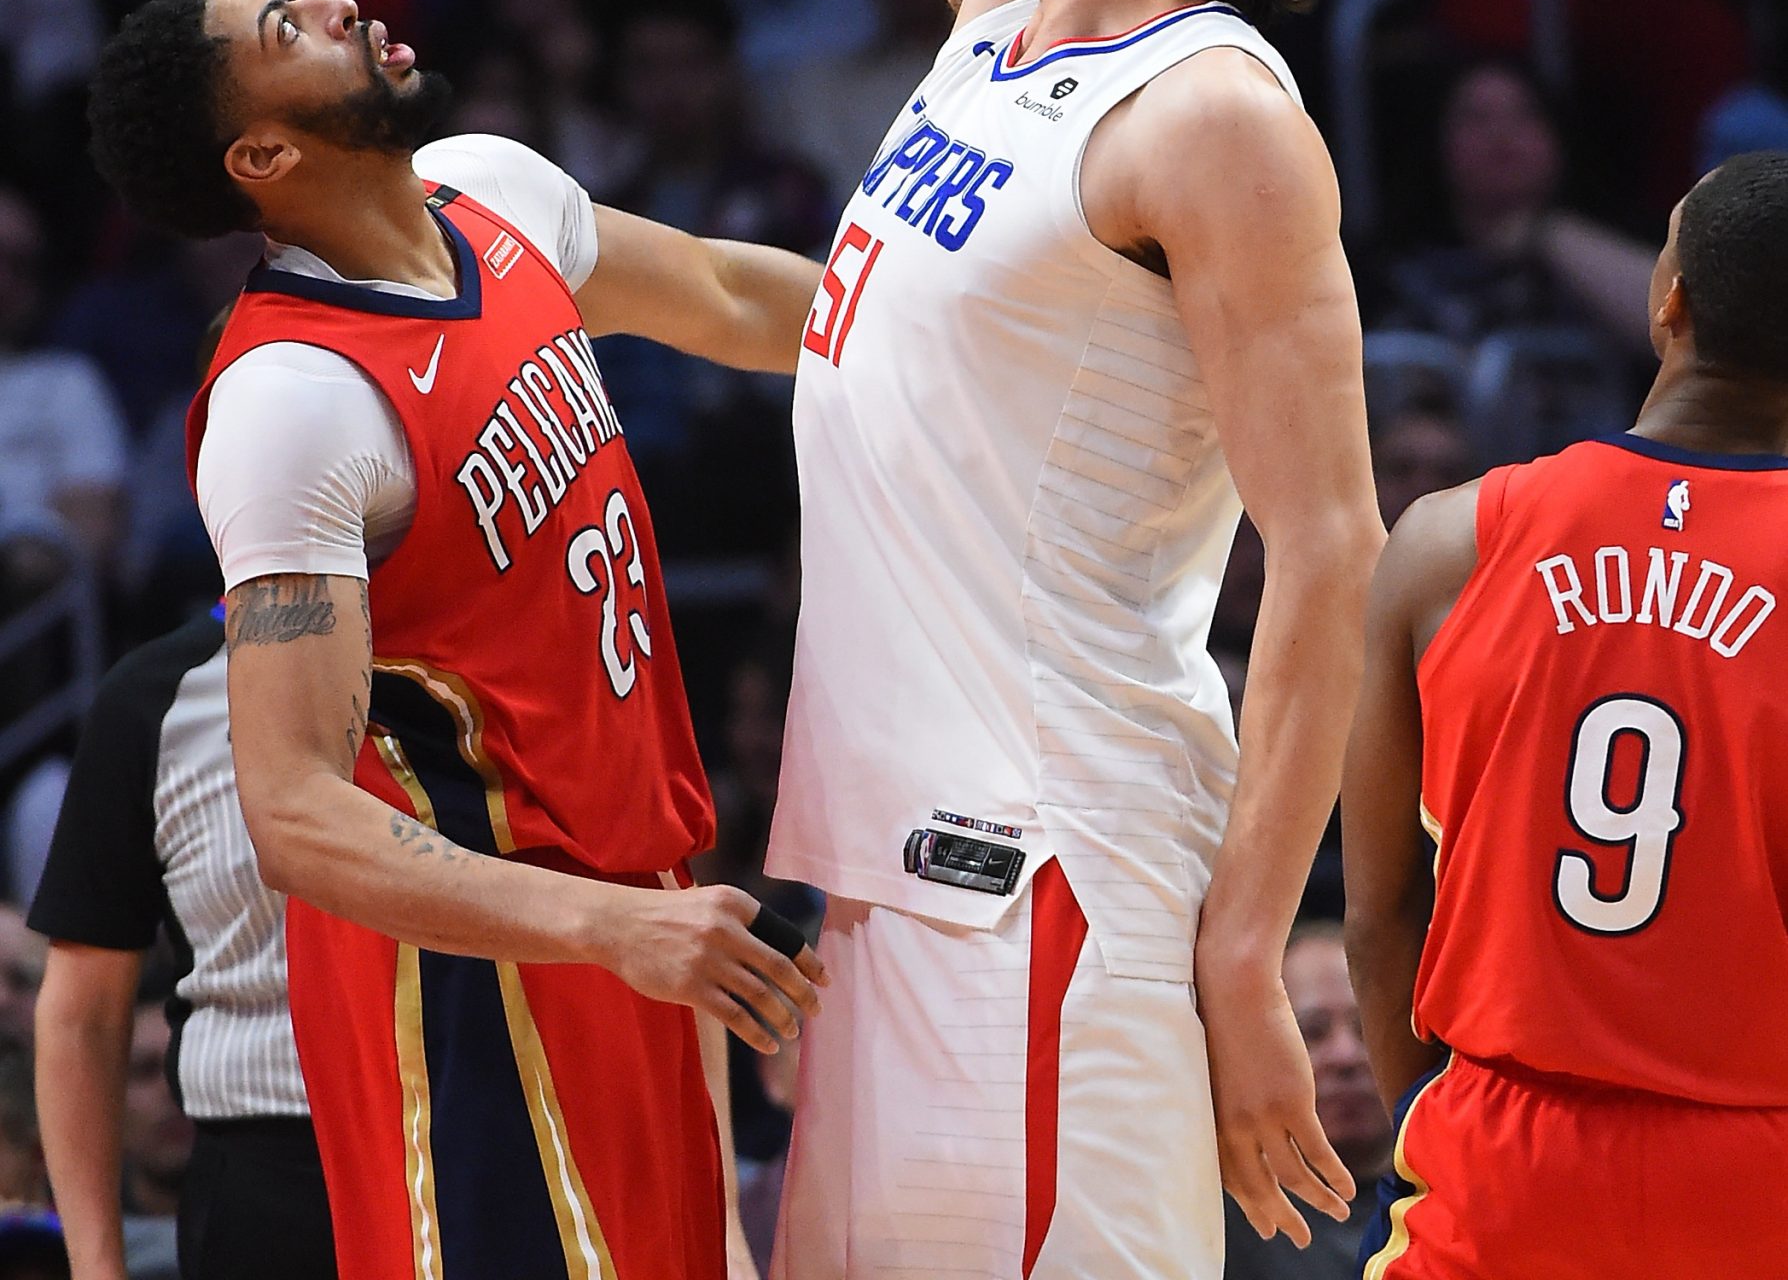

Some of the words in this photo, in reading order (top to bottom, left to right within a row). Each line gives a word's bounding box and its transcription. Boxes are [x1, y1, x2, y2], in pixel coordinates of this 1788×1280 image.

[1014, 91, 1063, 122] bumble
[803, 222, 884, 368] 51
[566, 488, 652, 699] 23
[1535, 545, 1776, 658] RONDO
[1553, 692, 1687, 937] 9
